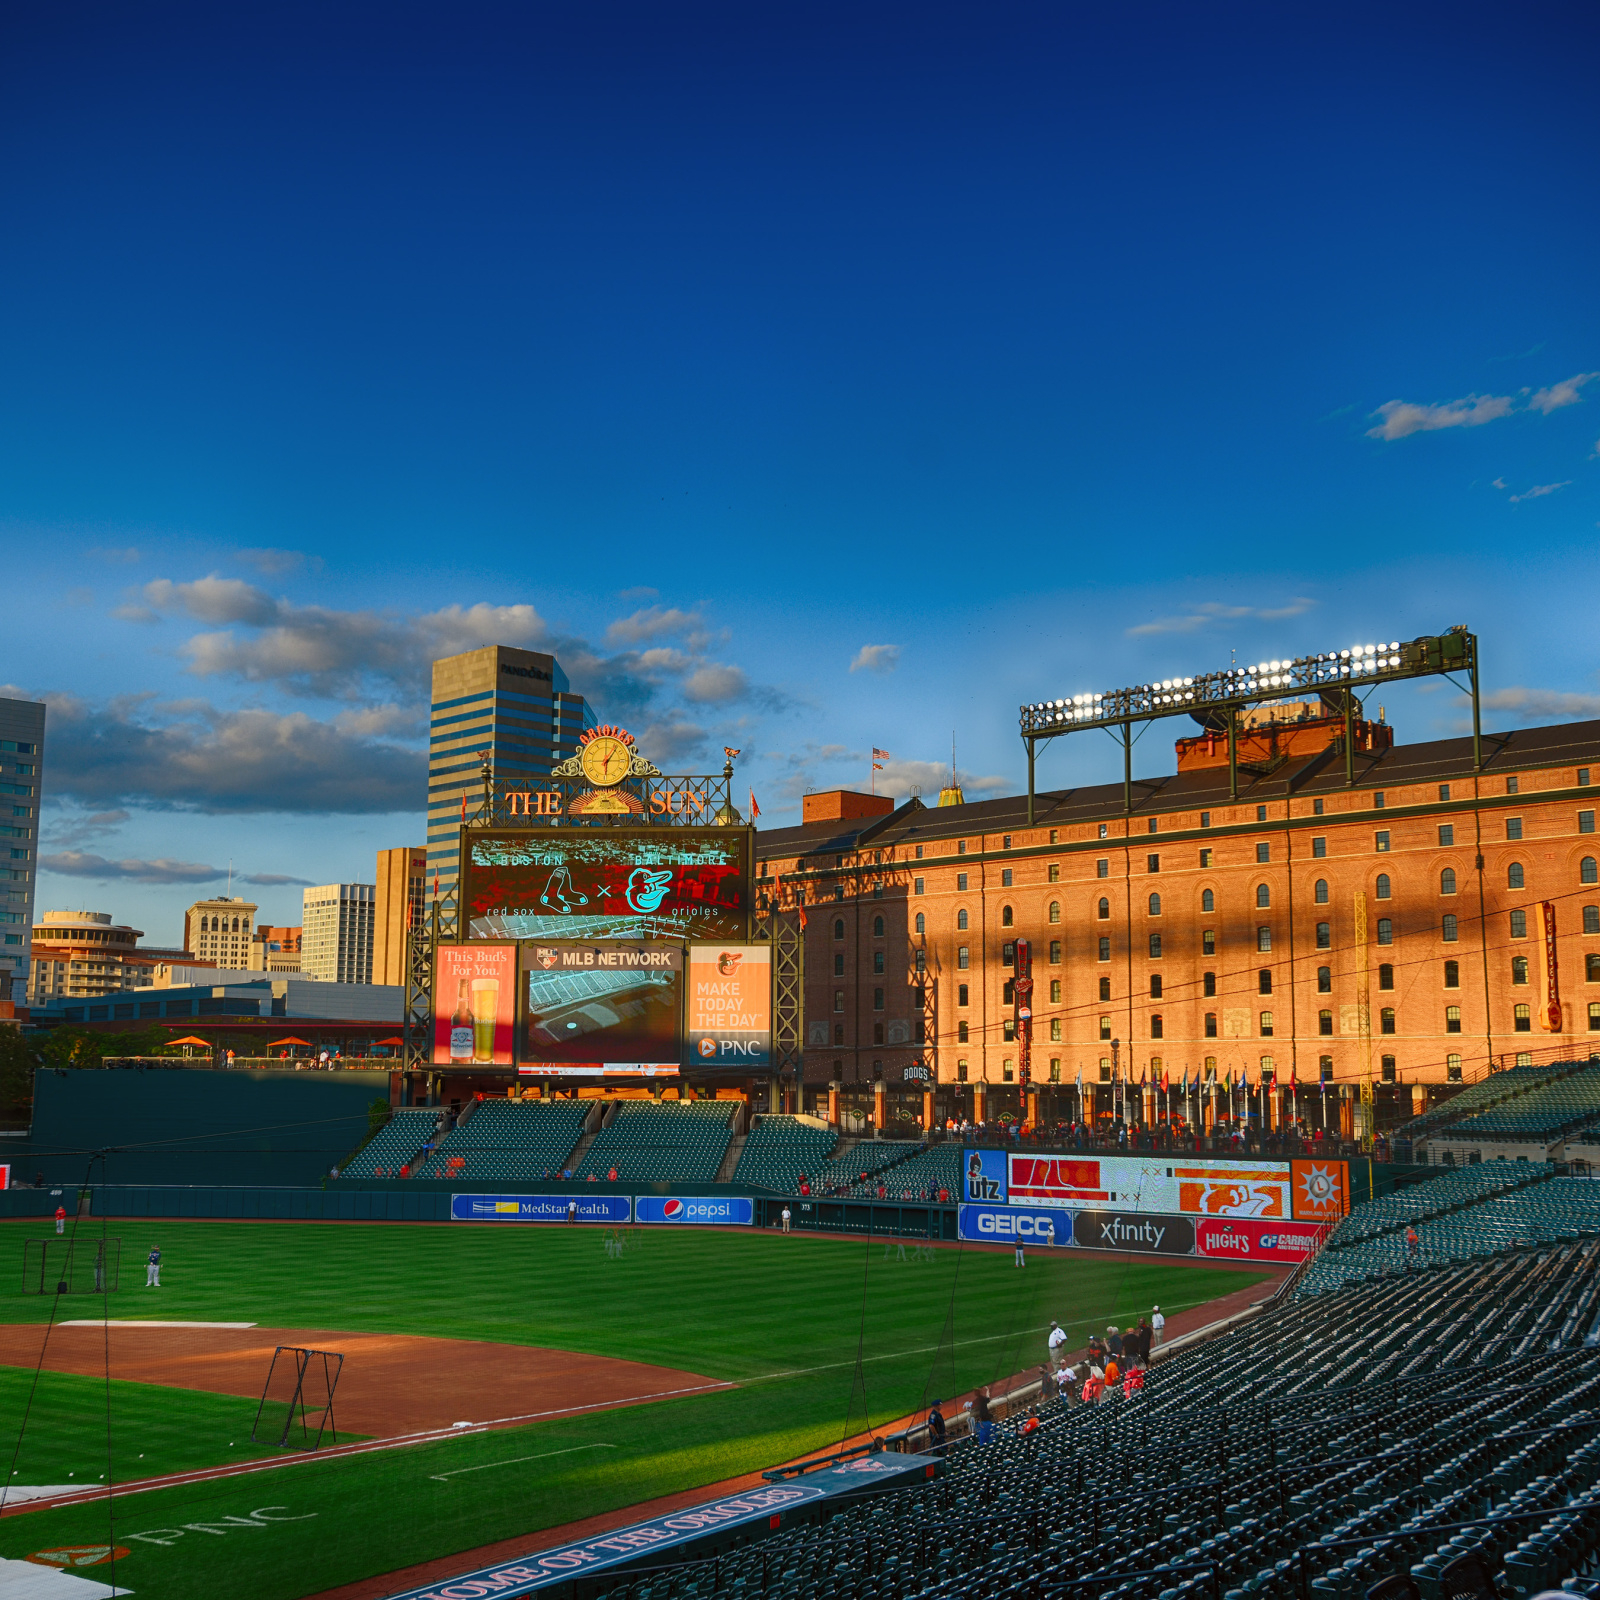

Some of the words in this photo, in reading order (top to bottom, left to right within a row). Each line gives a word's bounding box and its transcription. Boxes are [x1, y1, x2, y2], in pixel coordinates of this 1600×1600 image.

[501, 664, 553, 682] PANDORA
[579, 724, 635, 746] ORIOLES
[505, 791, 563, 815] THE
[650, 790, 707, 815] SUN
[500, 855, 563, 866] BOSTON
[635, 855, 727, 866] BALTIMORE
[486, 906, 508, 916] red
[513, 908, 535, 916] sox
[671, 906, 718, 916] orioles
[445, 950, 473, 962] This
[476, 950, 507, 962] Bud's
[562, 952, 594, 966] MLB
[598, 952, 672, 966] NETWORK
[451, 964, 472, 976] For
[474, 964, 500, 976] You.
[697, 982, 740, 995] MAKE
[696, 998, 744, 1011] TODAY
[696, 1013, 725, 1027] THE
[719, 1040, 761, 1056] PNC
[1316, 1182, 1324, 1192] L
[521, 1203, 570, 1214] MedStar
[687, 1202, 730, 1218] pepsi
[801, 1203, 811, 1211] 373
[977, 1213, 1054, 1236] GEICO
[1100, 1217, 1166, 1249] xfinity
[1205, 1232, 1250, 1253] HIGH'S
[119, 1506, 319, 1546] PNC
[586, 1527, 679, 1553] THE
[663, 1489, 804, 1532] ORIOLES
